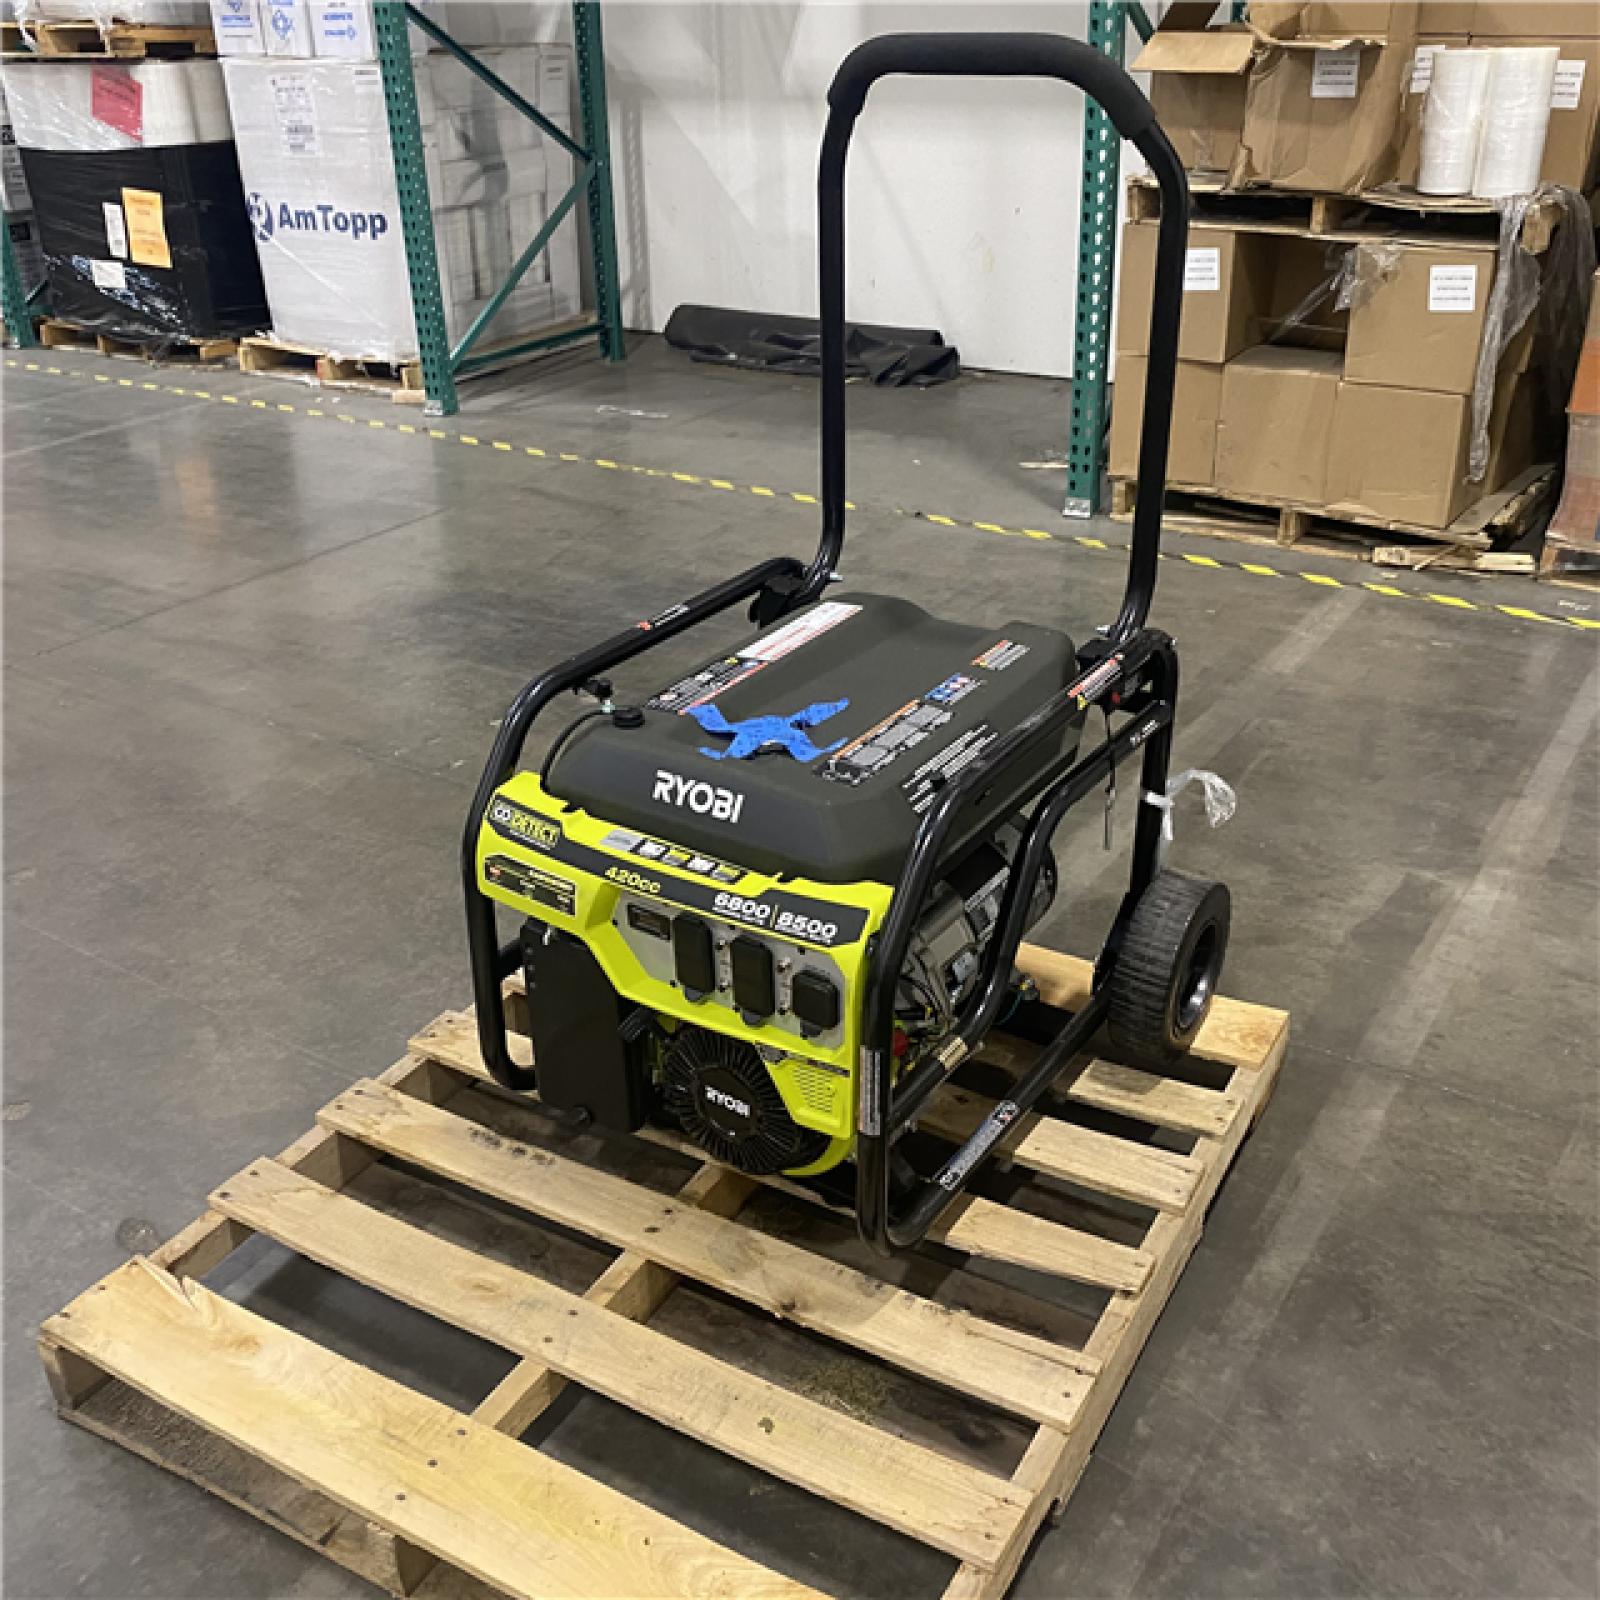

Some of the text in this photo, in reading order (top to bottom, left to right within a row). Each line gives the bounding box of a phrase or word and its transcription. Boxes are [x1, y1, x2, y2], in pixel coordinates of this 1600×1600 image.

[279, 203, 388, 240] AmTopp
[652, 769, 745, 823] RYOBI
[777, 911, 837, 939] 8500
[704, 1085, 751, 1118] RYOBI
